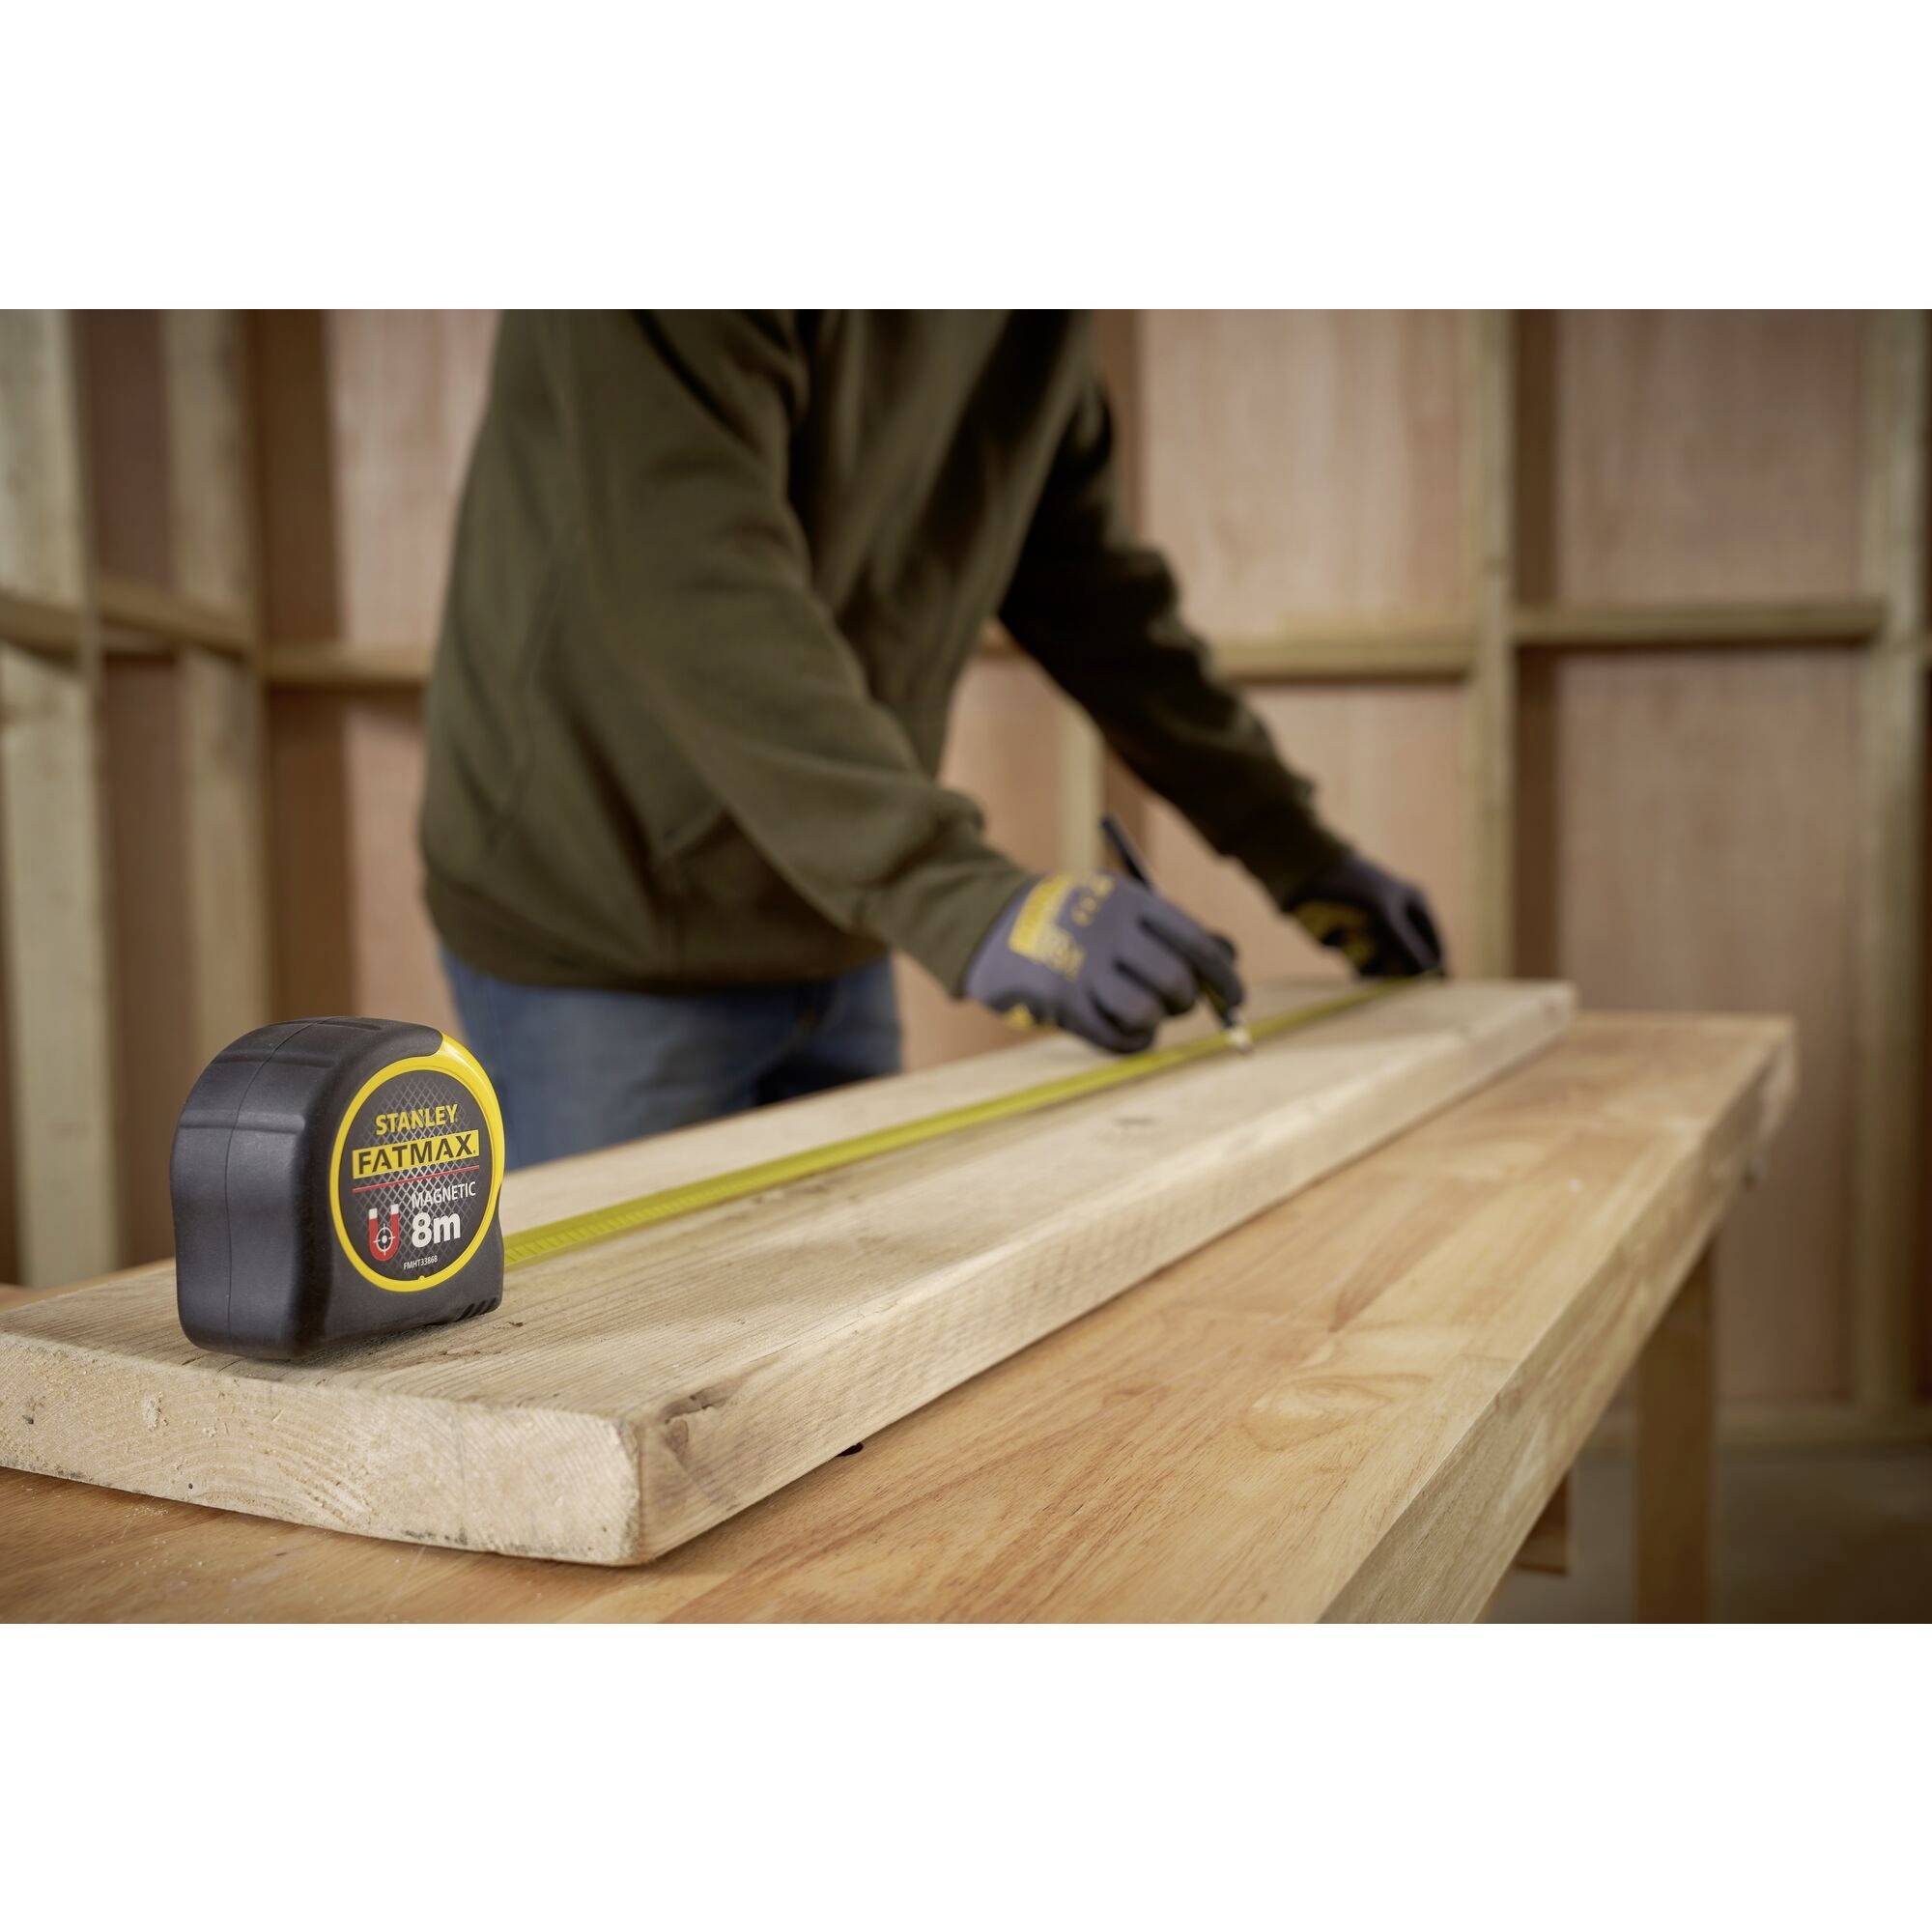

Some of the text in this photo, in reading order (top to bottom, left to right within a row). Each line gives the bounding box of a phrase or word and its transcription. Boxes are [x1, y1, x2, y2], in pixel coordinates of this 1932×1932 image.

[375, 1103, 459, 1136] STANLEY
[358, 1133, 472, 1175] FATMAX
[412, 1181, 476, 1208] MAGNETIC
[412, 1211, 461, 1249] 8m
